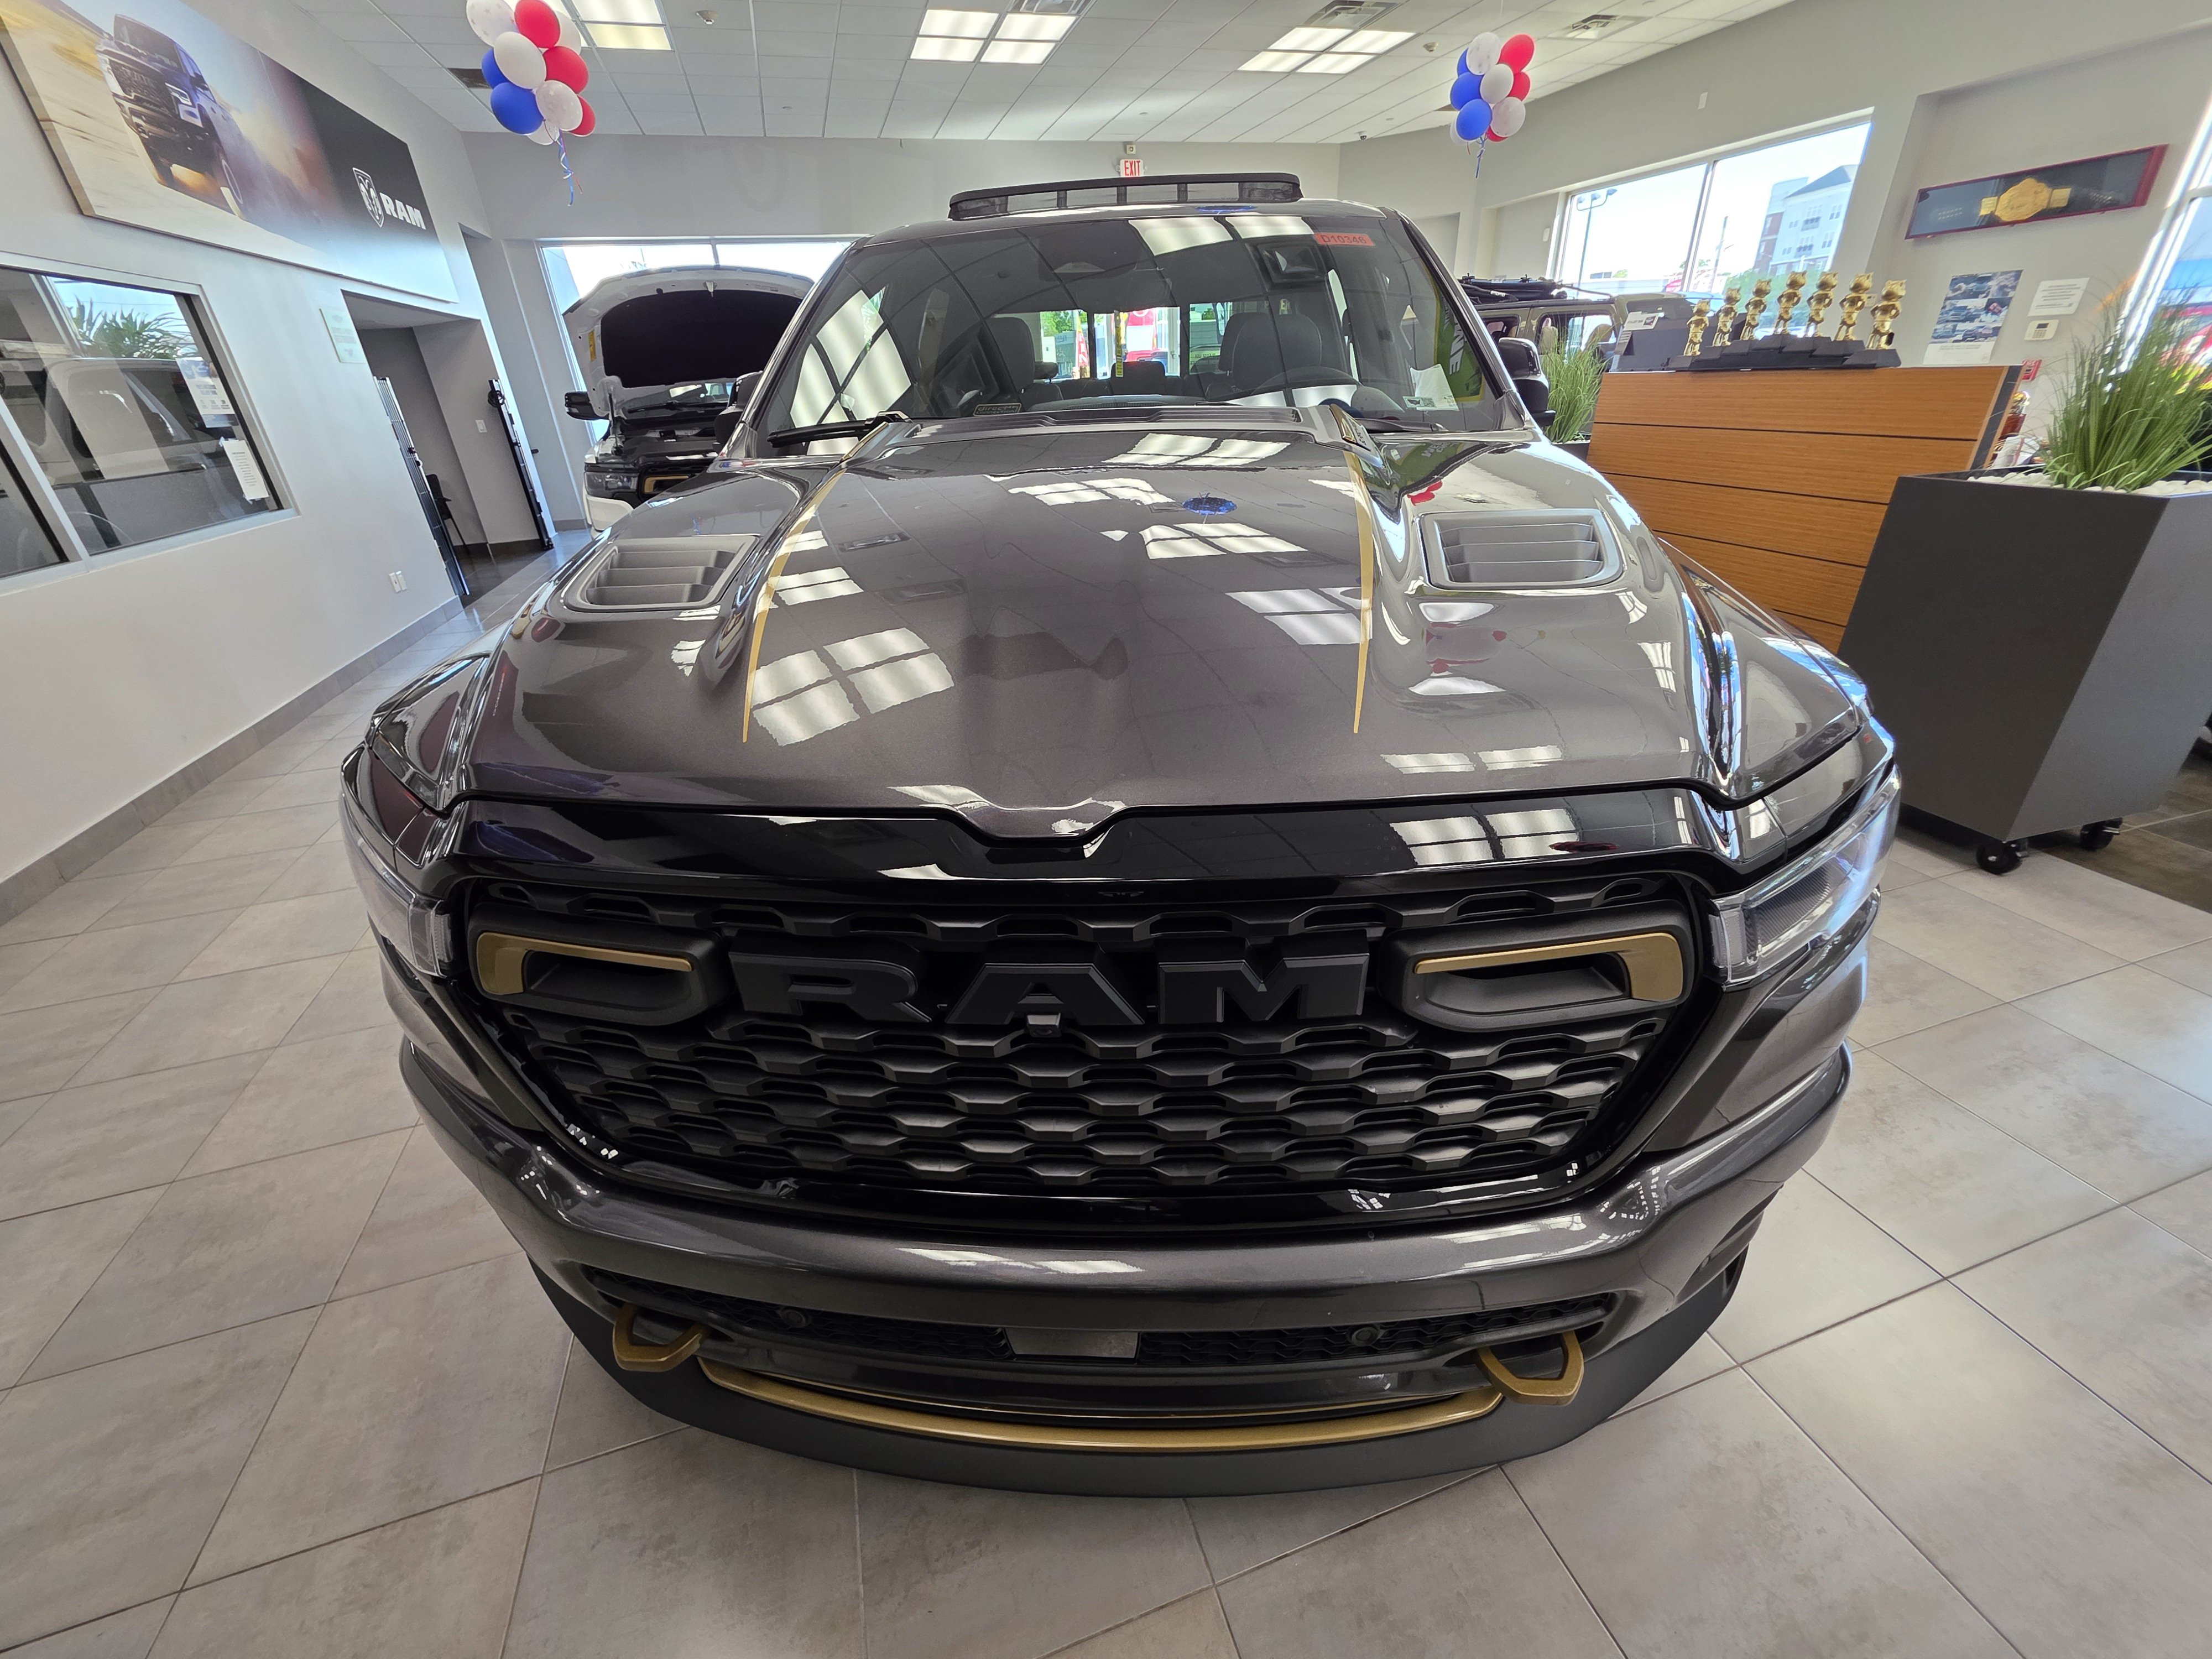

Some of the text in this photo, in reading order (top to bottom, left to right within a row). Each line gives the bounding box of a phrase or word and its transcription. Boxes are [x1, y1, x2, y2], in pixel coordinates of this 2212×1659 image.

[1124, 160, 1141, 176] EXIT
[379, 191, 426, 230] RAM
[727, 945, 1370, 1026] RAM
